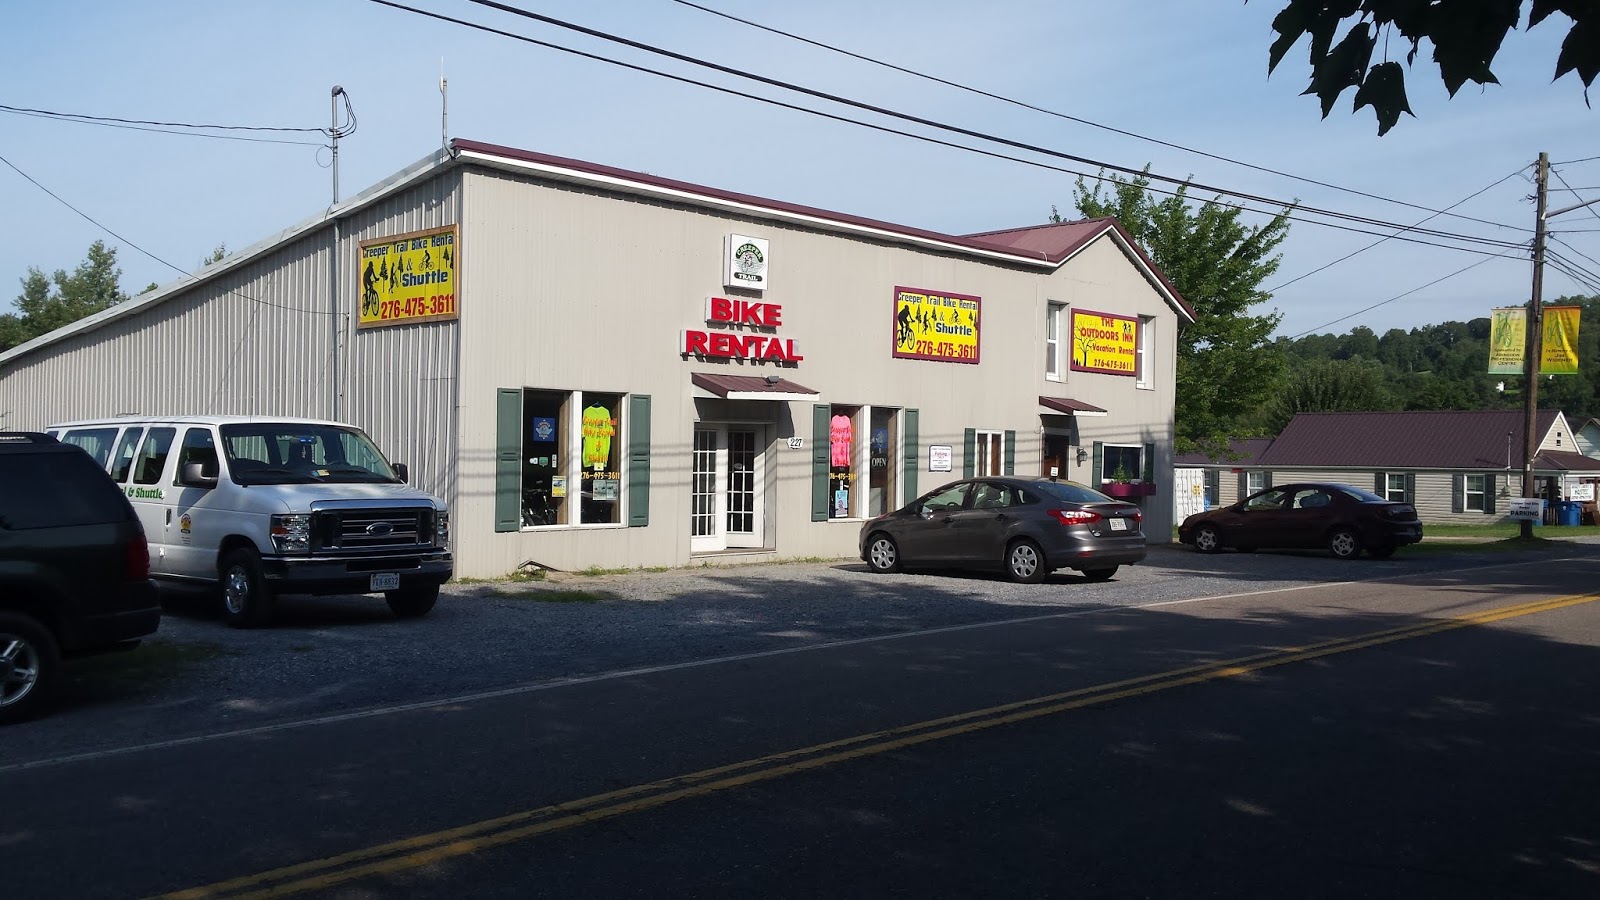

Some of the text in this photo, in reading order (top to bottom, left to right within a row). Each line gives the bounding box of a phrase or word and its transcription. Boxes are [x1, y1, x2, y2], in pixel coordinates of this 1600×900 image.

[363, 246, 389, 259] Creeper
[393, 240, 408, 254] Trail
[412, 237, 428, 250] Bike
[736, 244, 763, 260] CREEPER
[406, 258, 412, 272] &
[402, 269, 448, 288] Shuttle
[738, 273, 759, 281] TRAIL
[381, 294, 454, 320] 276-475-3611
[898, 292, 923, 305] Creeper
[926, 295, 940, 306] Trail
[943, 297, 956, 308] Bike
[711, 298, 782, 326] BIKE
[936, 322, 972, 336] Shuttle
[1102, 316, 1114, 328] THE
[1080, 327, 1133, 343] OUTDOORS INN
[686, 330, 804, 362] RENTAL
[916, 340, 976, 358] 276-475-3611
[1092, 343, 1134, 356] Vacation Rental
[1094, 358, 1132, 370] 276-475-3611
[790, 438, 802, 447] 227
[872, 458, 886, 467] OPEN
[128, 488, 134, 497] &
[136, 487, 163, 499] Shuttle
